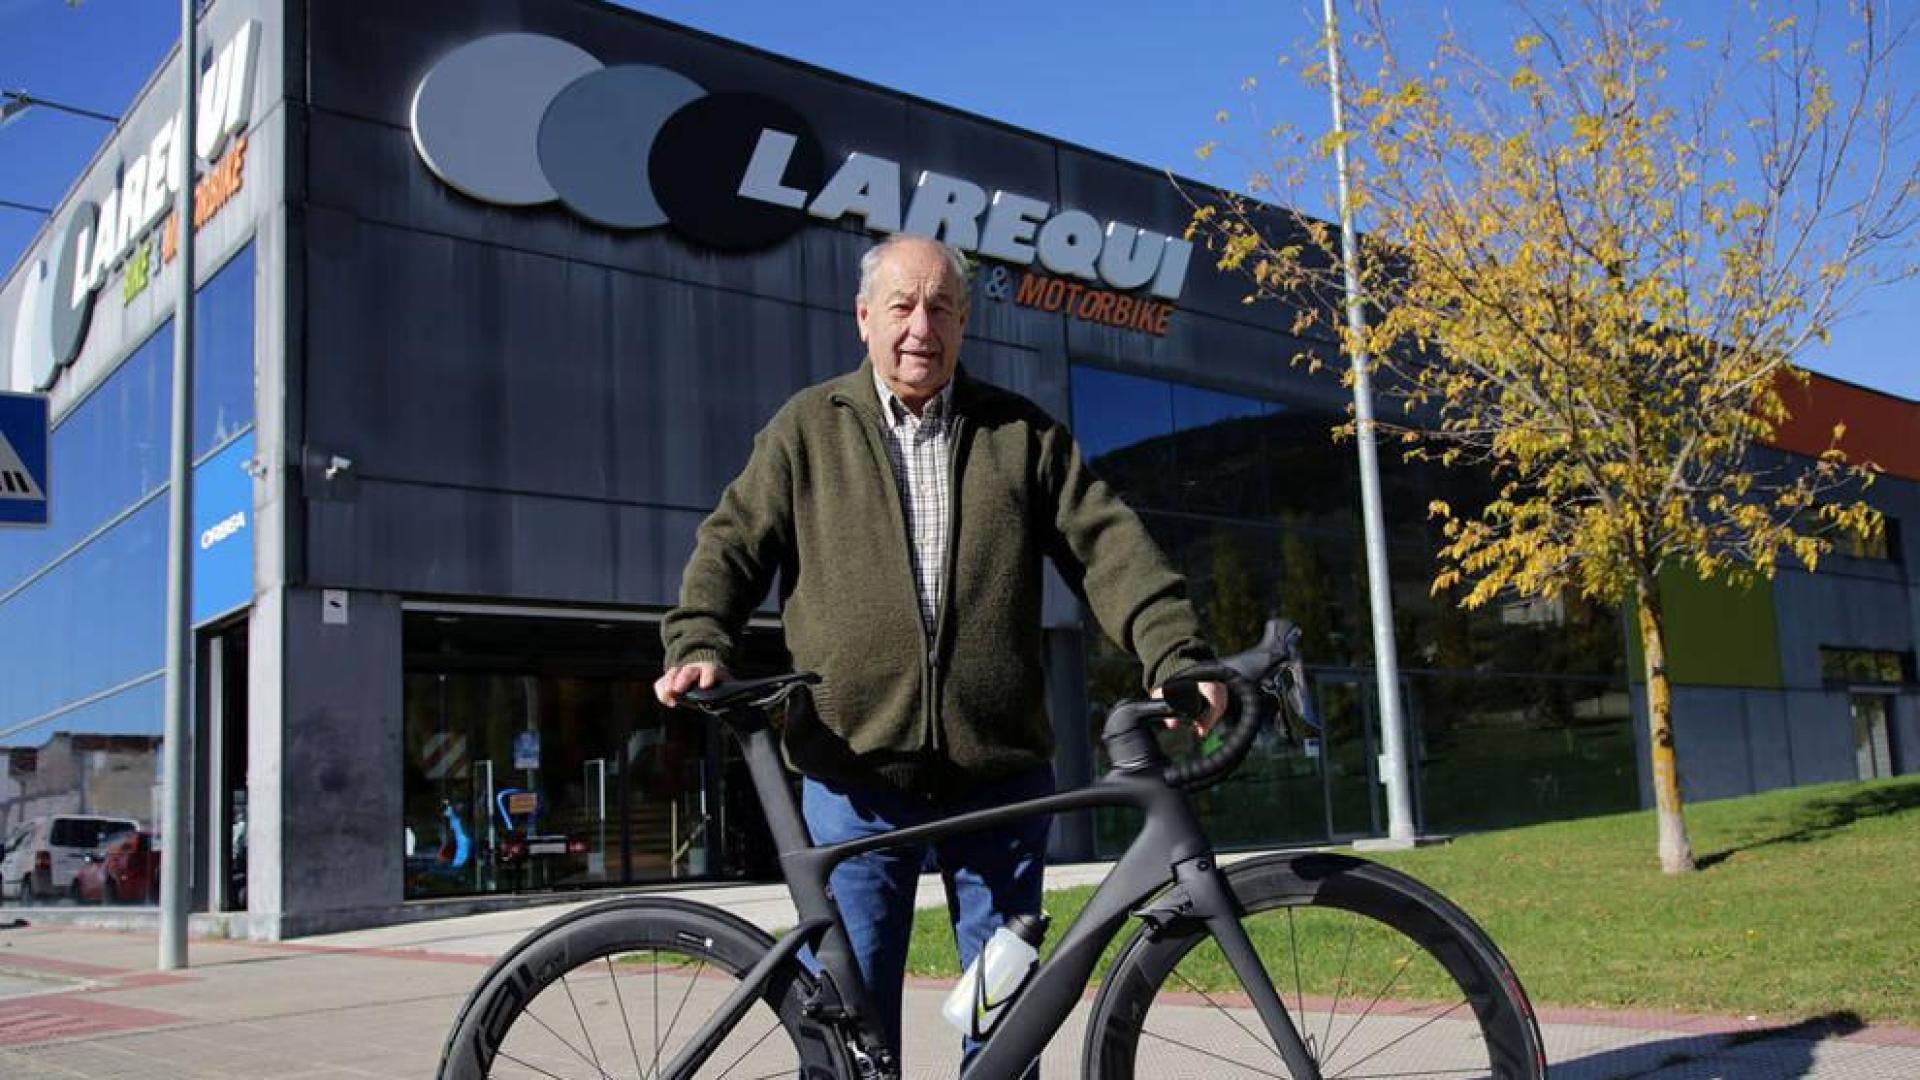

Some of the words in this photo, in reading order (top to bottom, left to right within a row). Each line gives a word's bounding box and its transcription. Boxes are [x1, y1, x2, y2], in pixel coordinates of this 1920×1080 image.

[737, 127, 1195, 299] LAREQUI
[984, 264, 1008, 298] &
[1016, 272, 1177, 336] MOTORBIKE
